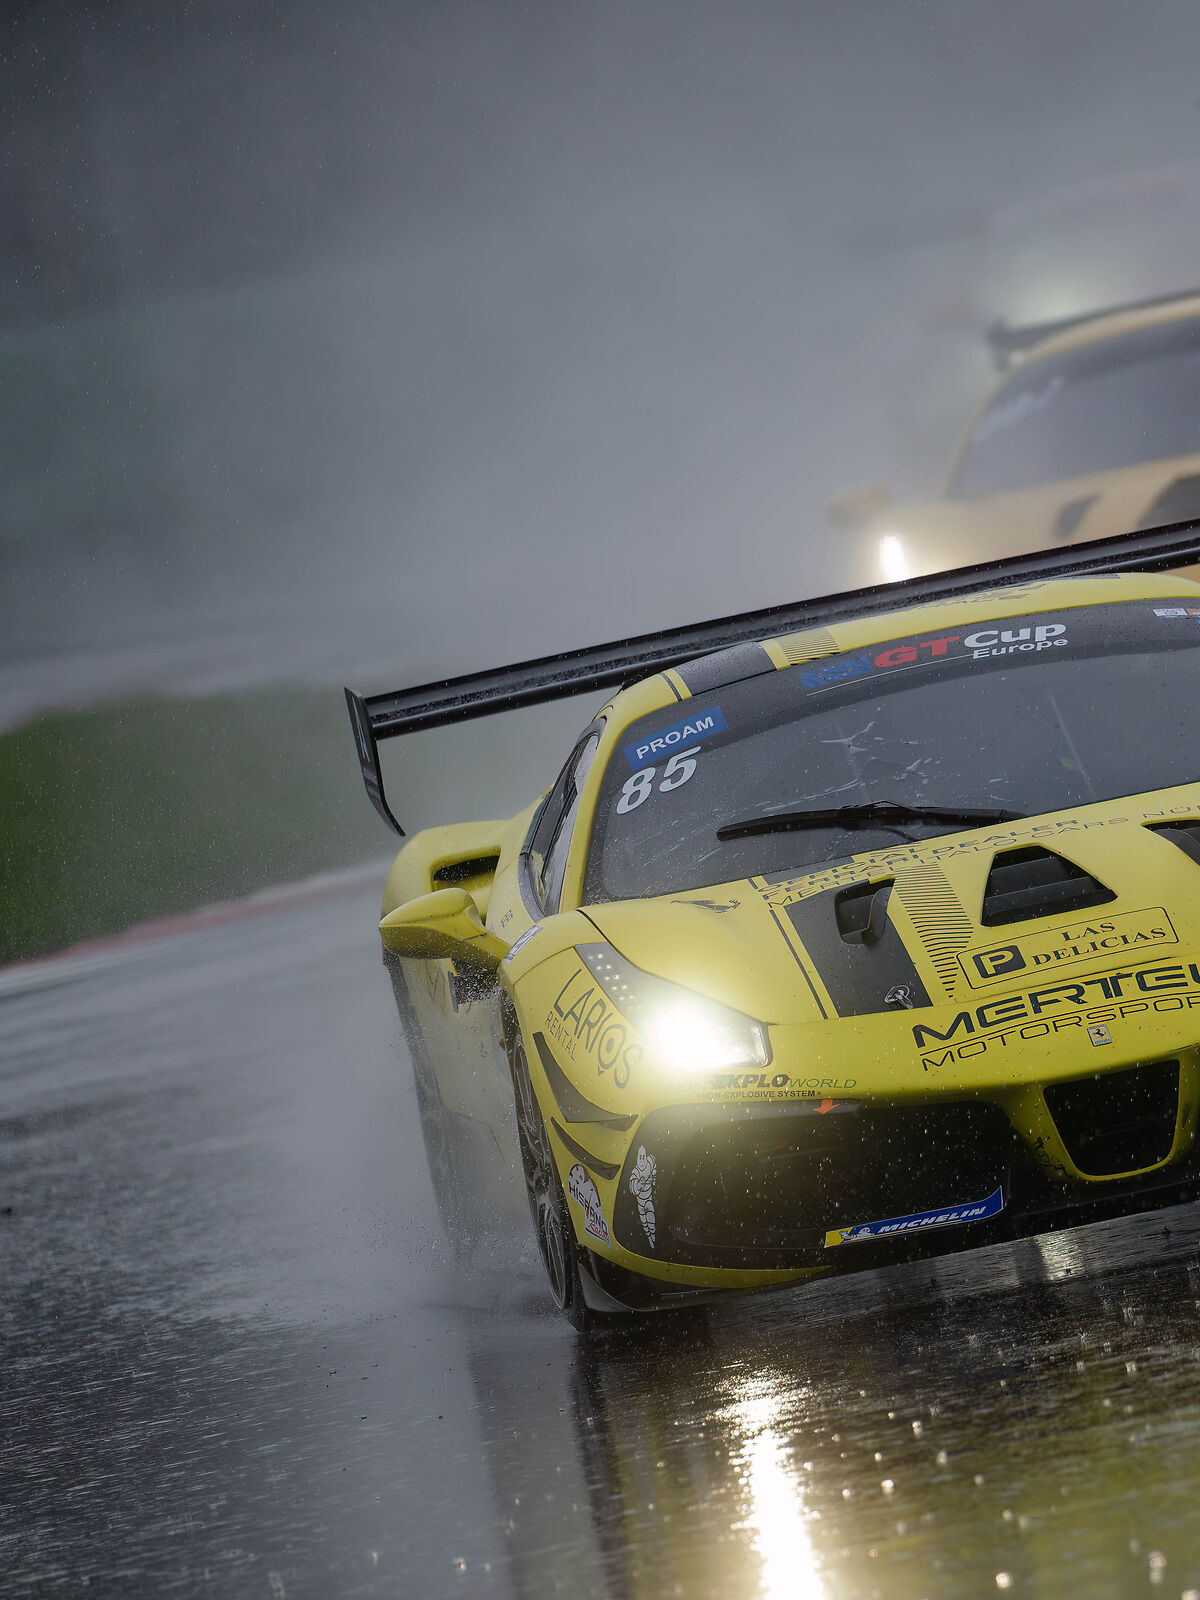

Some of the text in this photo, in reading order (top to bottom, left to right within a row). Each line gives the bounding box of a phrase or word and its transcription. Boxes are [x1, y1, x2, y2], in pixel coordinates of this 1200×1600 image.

[874, 624, 1067, 667] GT Cup
[972, 639, 1069, 660] Europe
[635, 716, 715, 760] PROAM
[616, 746, 702, 815] 85
[932, 819, 1079, 855] DEALER
[1032, 927, 1167, 966] DELICIAS
[1061, 921, 1116, 943] LAS
[545, 1010, 577, 1061] RENTAL
[553, 968, 643, 1090] LARIOS
[878, 1206, 986, 1233] MICHELIN
